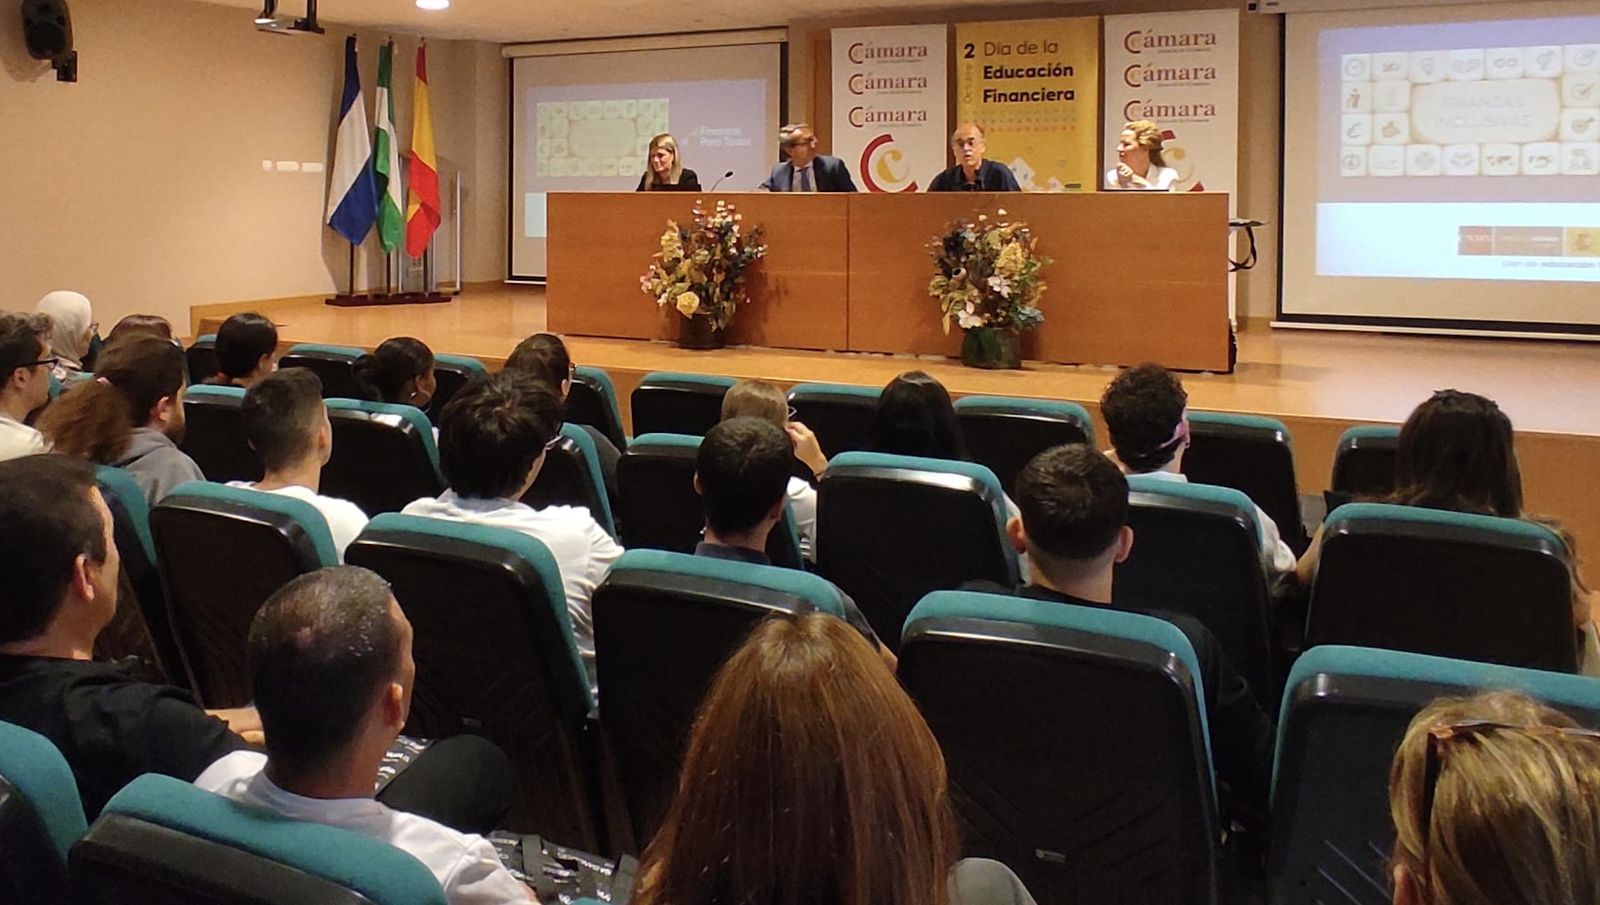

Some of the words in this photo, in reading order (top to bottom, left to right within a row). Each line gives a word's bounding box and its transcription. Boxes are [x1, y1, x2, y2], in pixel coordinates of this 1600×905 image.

[964, 43, 975, 58] 2
[1016, 40, 1038, 55] de
[1043, 39, 1058, 54] la
[1124, 28, 1216, 54] Cámara
[847, 42, 928, 64] Cámara
[983, 62, 1073, 79] Educación
[1124, 62, 1216, 87] Cámara
[847, 73, 928, 95] Cámara
[983, 87, 1075, 103] Financiera
[848, 106, 927, 128] Cámara
[1124, 99, 1215, 122] Cámara
